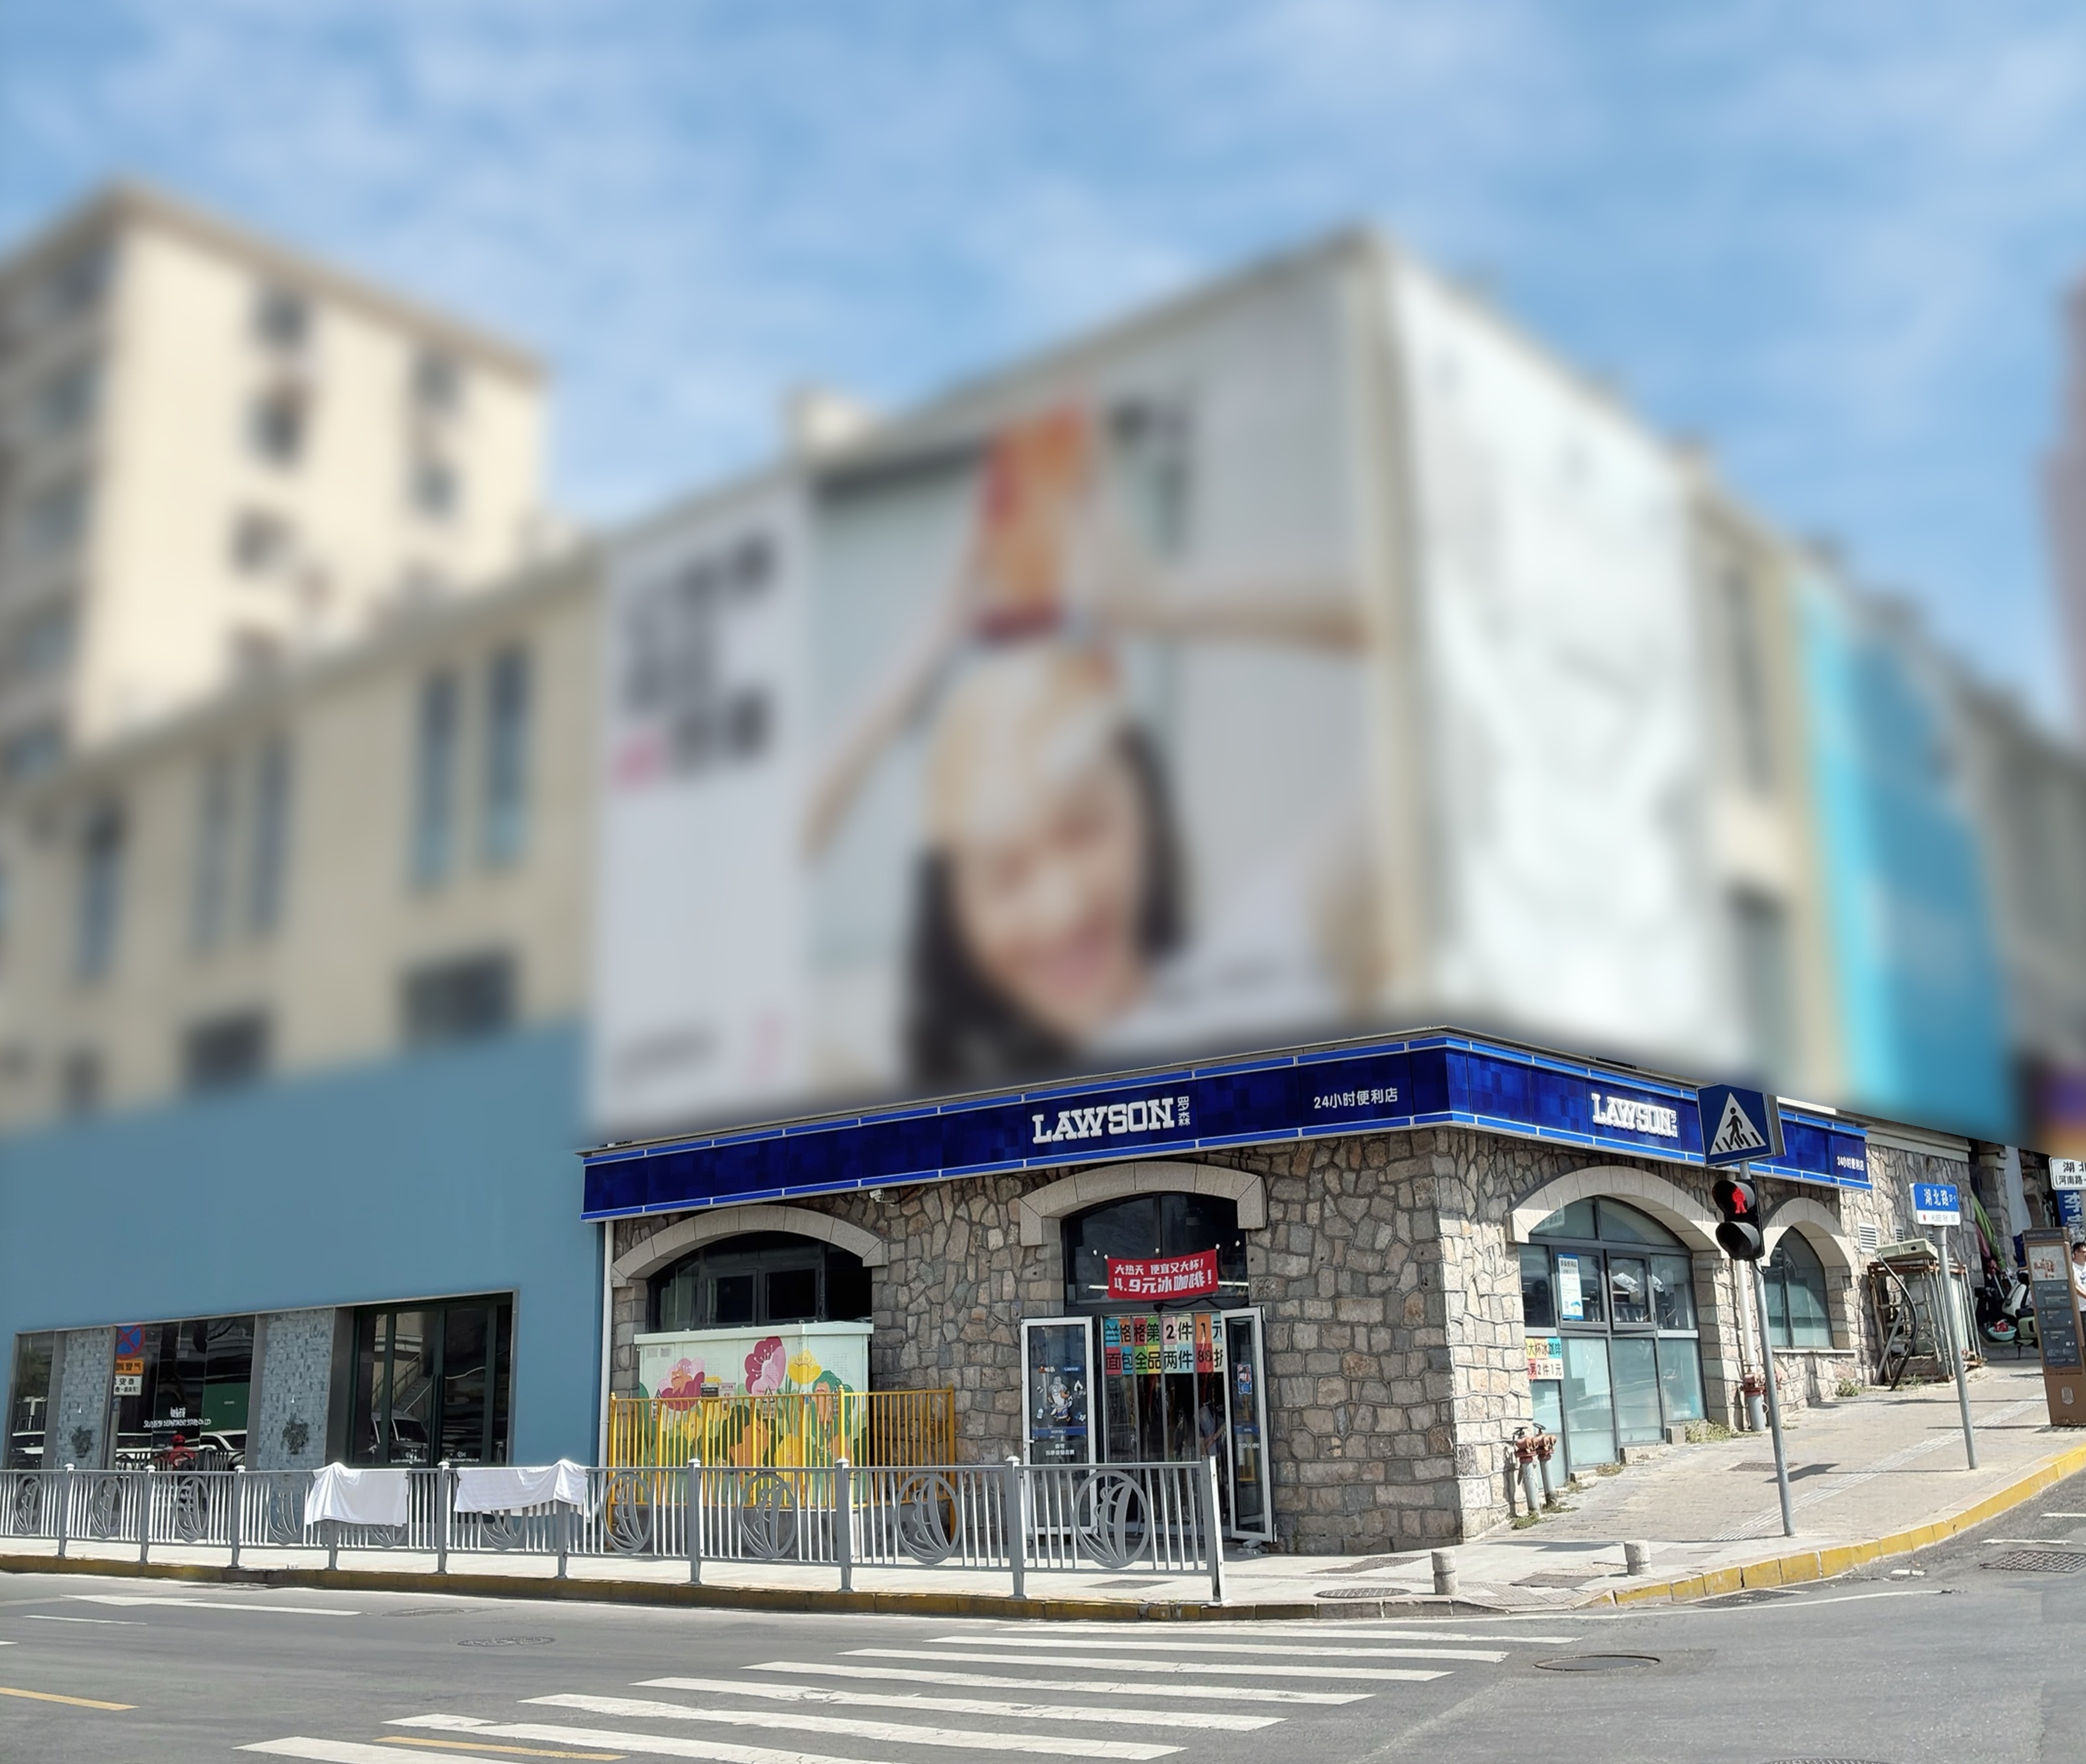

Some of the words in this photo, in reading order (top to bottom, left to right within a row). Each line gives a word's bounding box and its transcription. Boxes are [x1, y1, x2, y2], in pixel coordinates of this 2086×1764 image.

[1314, 1087, 1398, 1109] 24小时便利店
[1032, 1098, 1175, 1144] LAWSON
[1177, 1096, 1190, 1126] 罗森
[1591, 1093, 1672, 1137] LAWSON
[1115, 1264, 1144, 1275] 大热天
[1150, 1259, 1204, 1275] 便宜又大杯!
[1114, 1269, 1212, 1294] 4.9元冰咖啡!
[1528, 1363, 1562, 1376] 第2件1元
